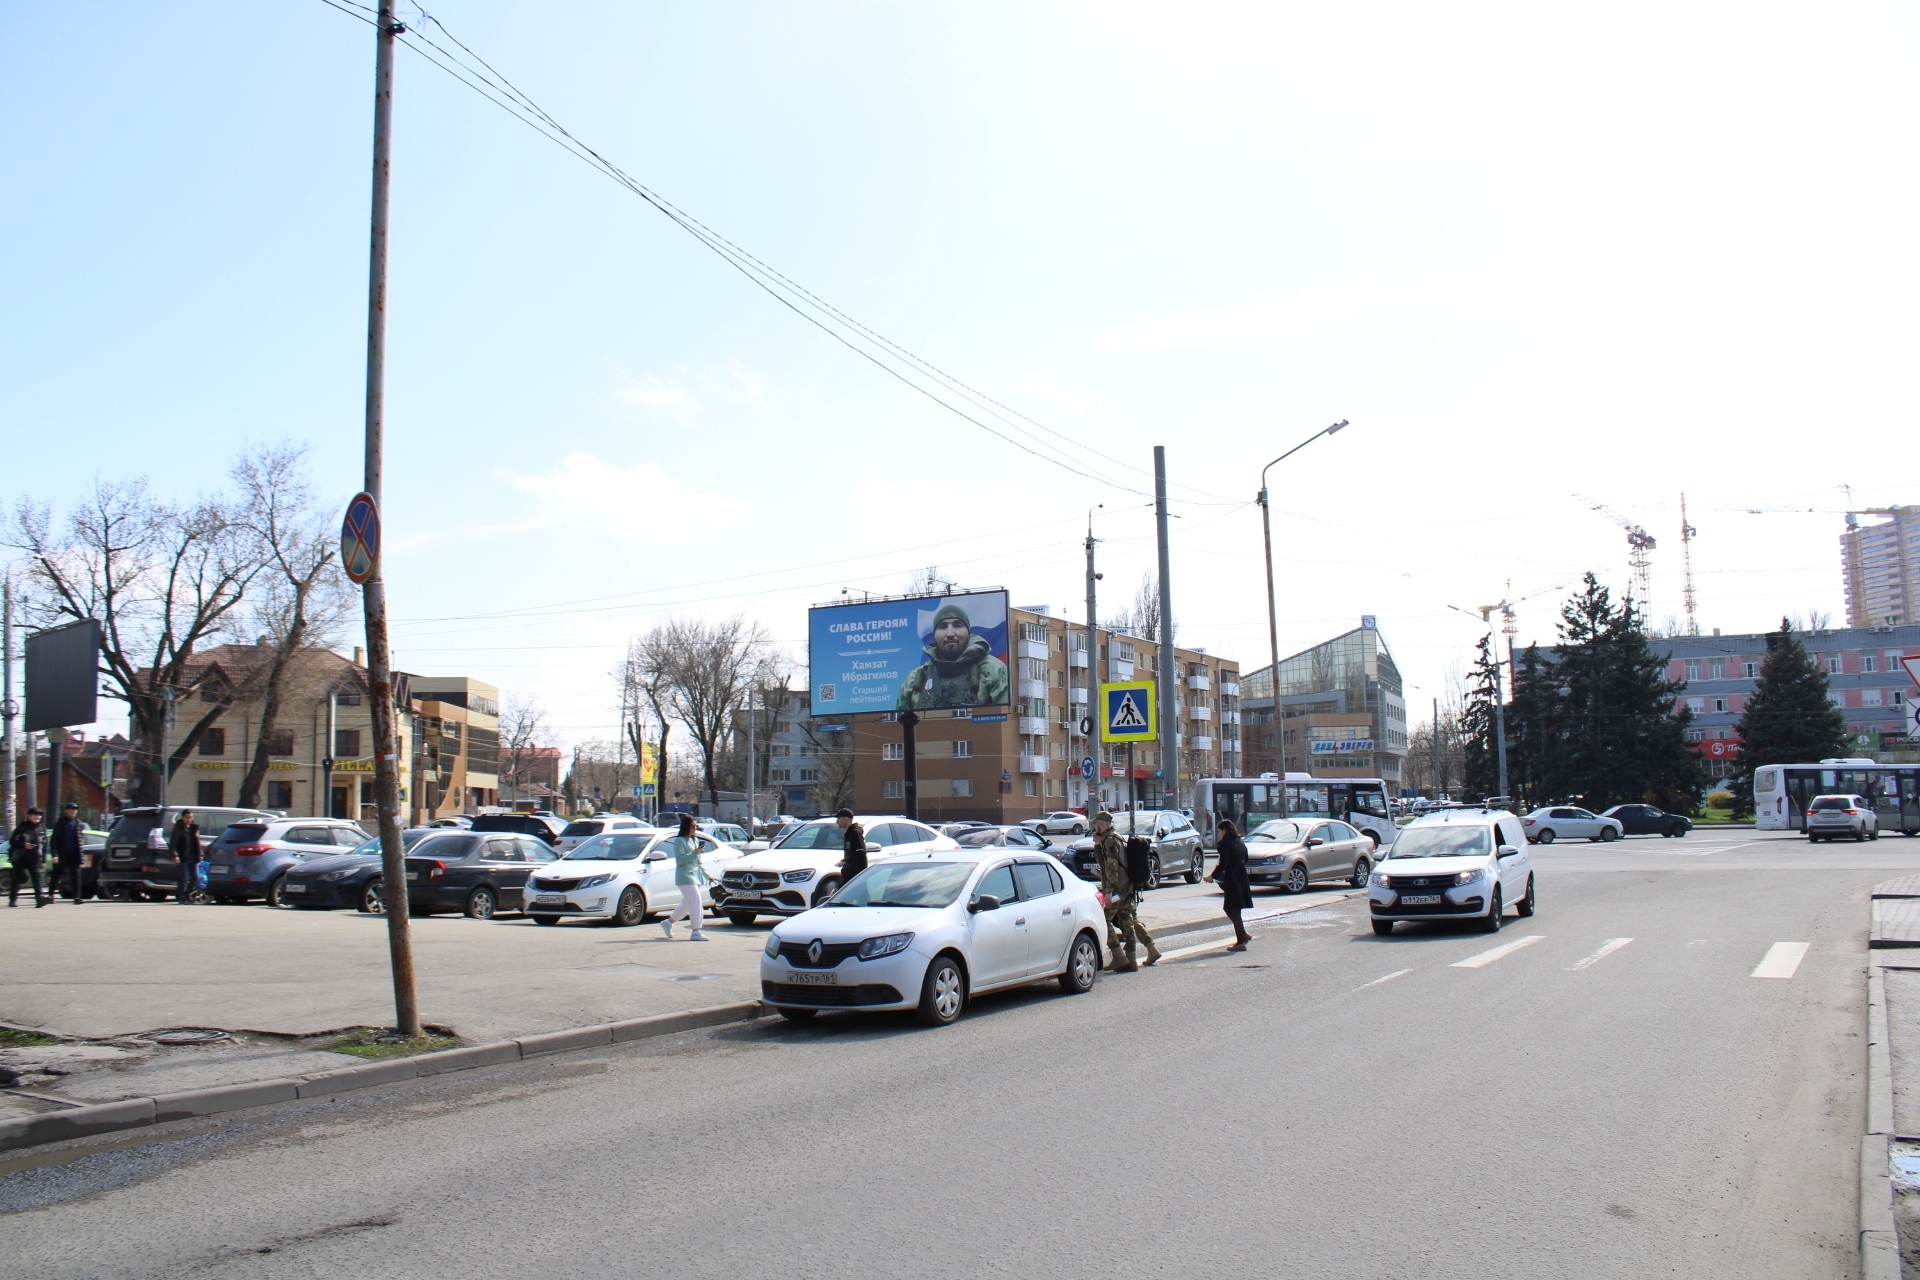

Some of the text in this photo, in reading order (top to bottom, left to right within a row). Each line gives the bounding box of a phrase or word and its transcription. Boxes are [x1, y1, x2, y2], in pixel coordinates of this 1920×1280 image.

[829, 618, 908, 633] СЛАВА ГЕРОЯМ
[846, 631, 892, 643] РОССИИ!
[851, 660, 888, 670] Хамзат
[842, 671, 898, 683] Ибрагимов
[852, 685, 888, 695] Старший
[849, 695, 891, 704] лейтенант
